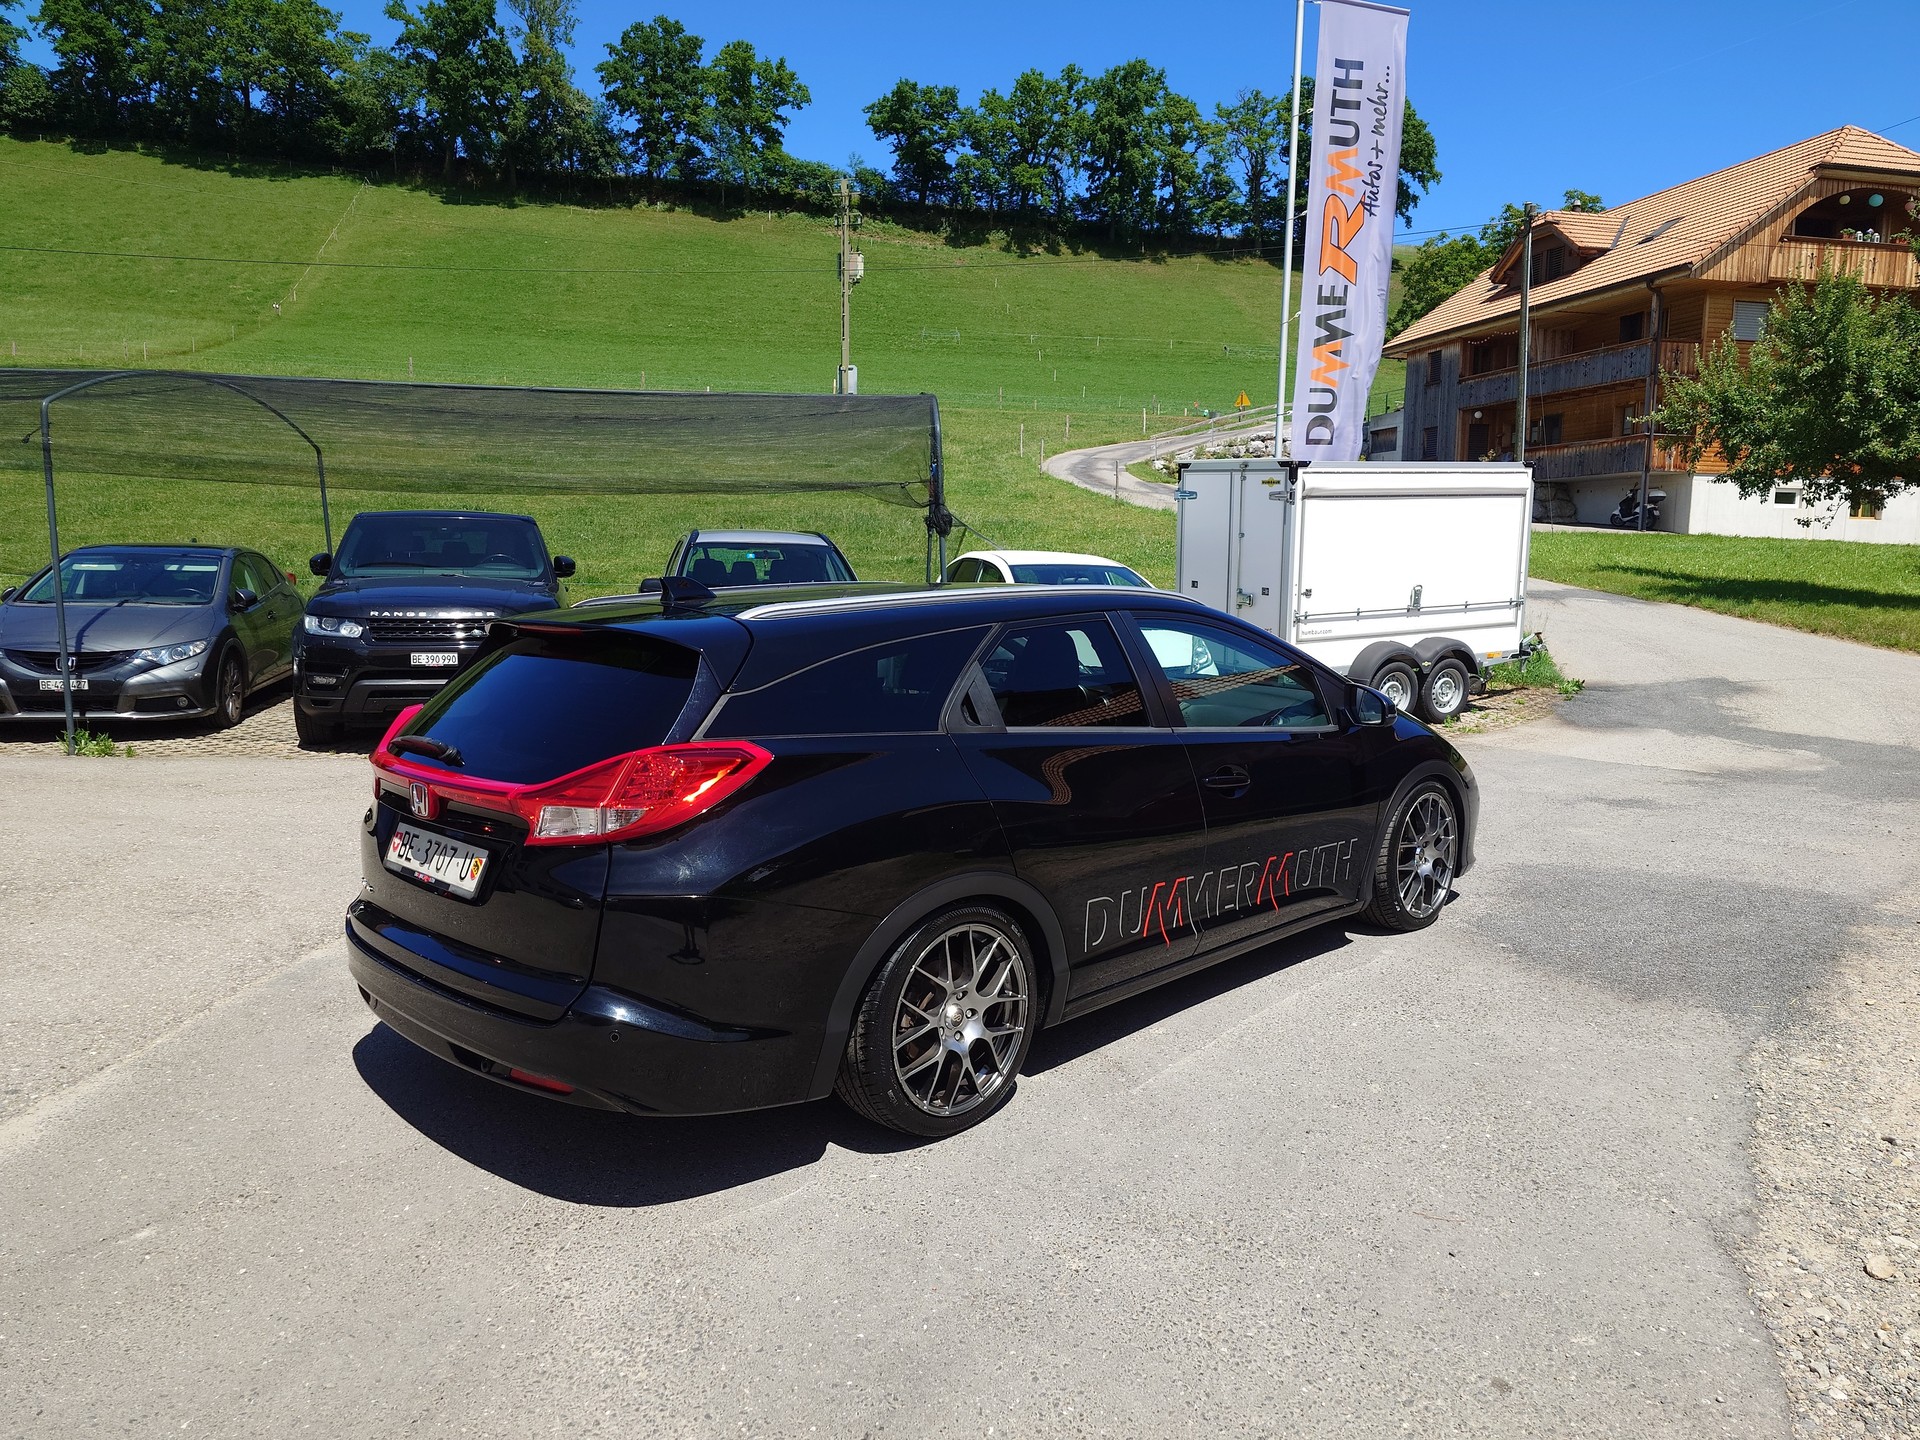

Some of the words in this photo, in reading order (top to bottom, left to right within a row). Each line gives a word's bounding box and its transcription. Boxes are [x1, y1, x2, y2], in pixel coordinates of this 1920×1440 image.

[1361, 161, 1384, 218] Autos
[1306, 57, 1365, 446] DUMMERMUTH
[1083, 838, 1359, 953] DUMMERMUTH
